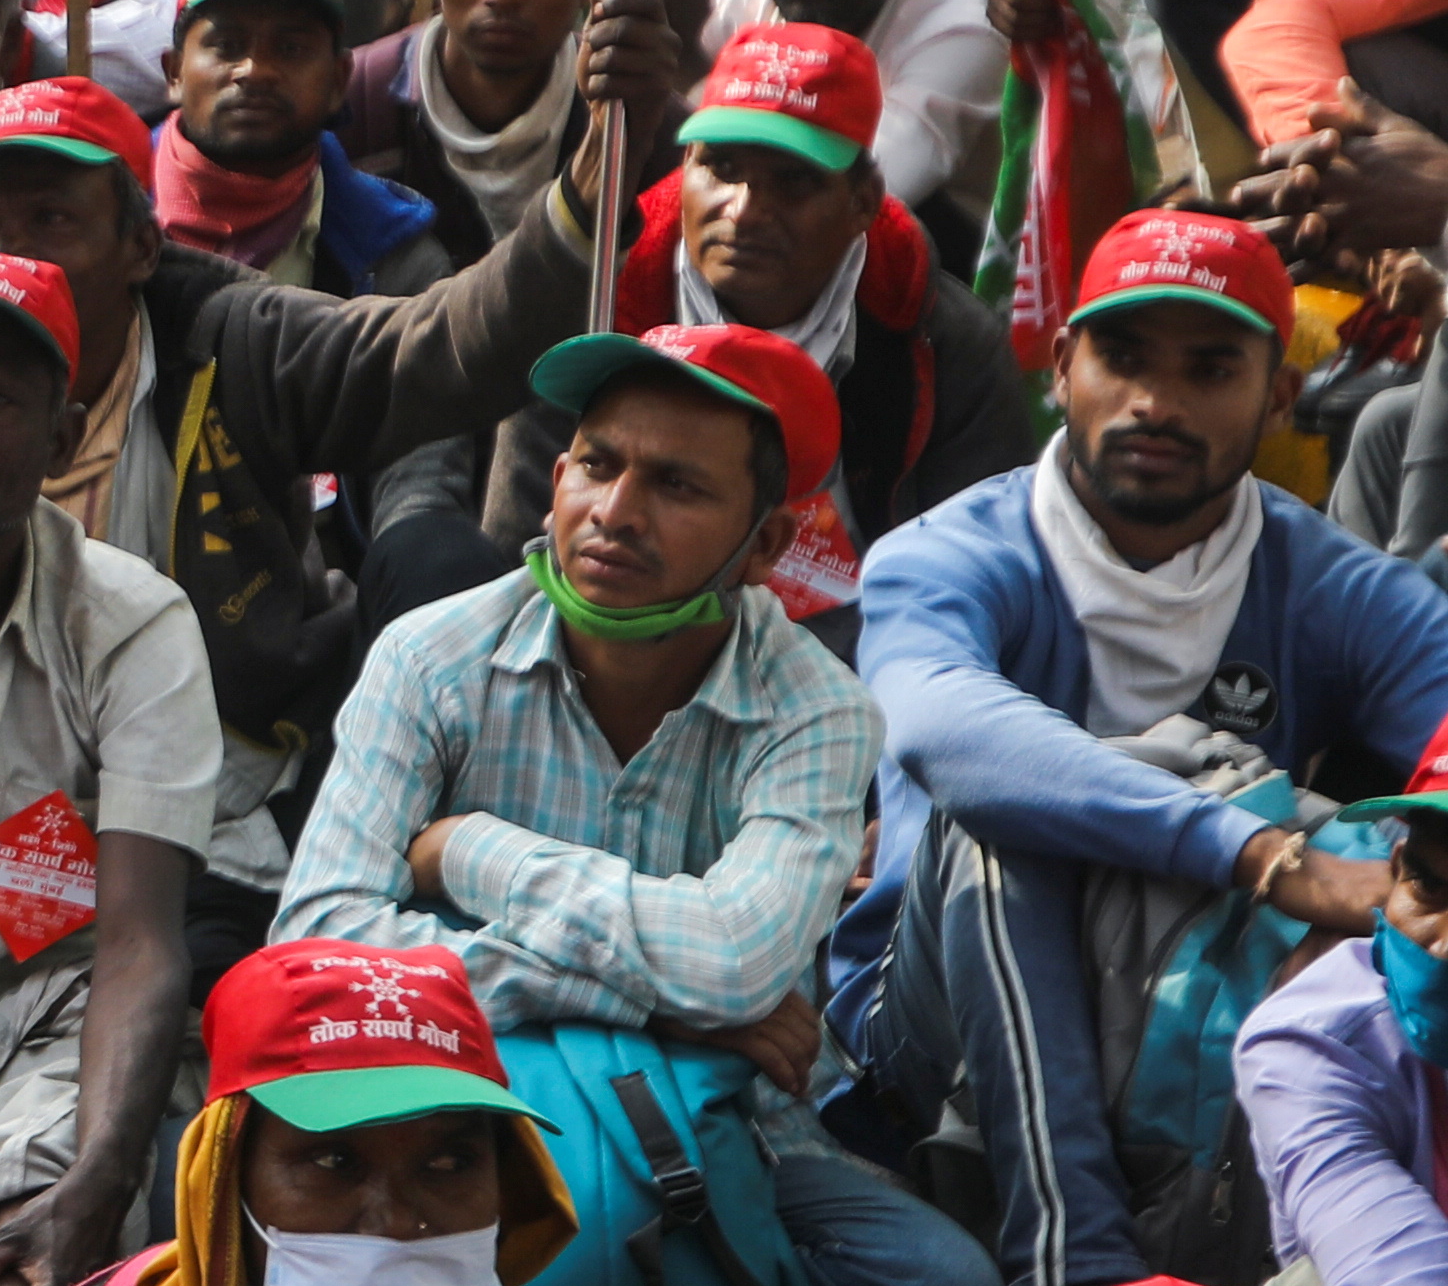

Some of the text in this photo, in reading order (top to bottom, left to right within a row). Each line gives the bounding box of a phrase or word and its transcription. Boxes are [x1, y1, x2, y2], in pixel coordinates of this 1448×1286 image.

[22, 846, 64, 871] संघर्ष
[309, 1012, 460, 1054] लोक संघर्ष मोर्चा
